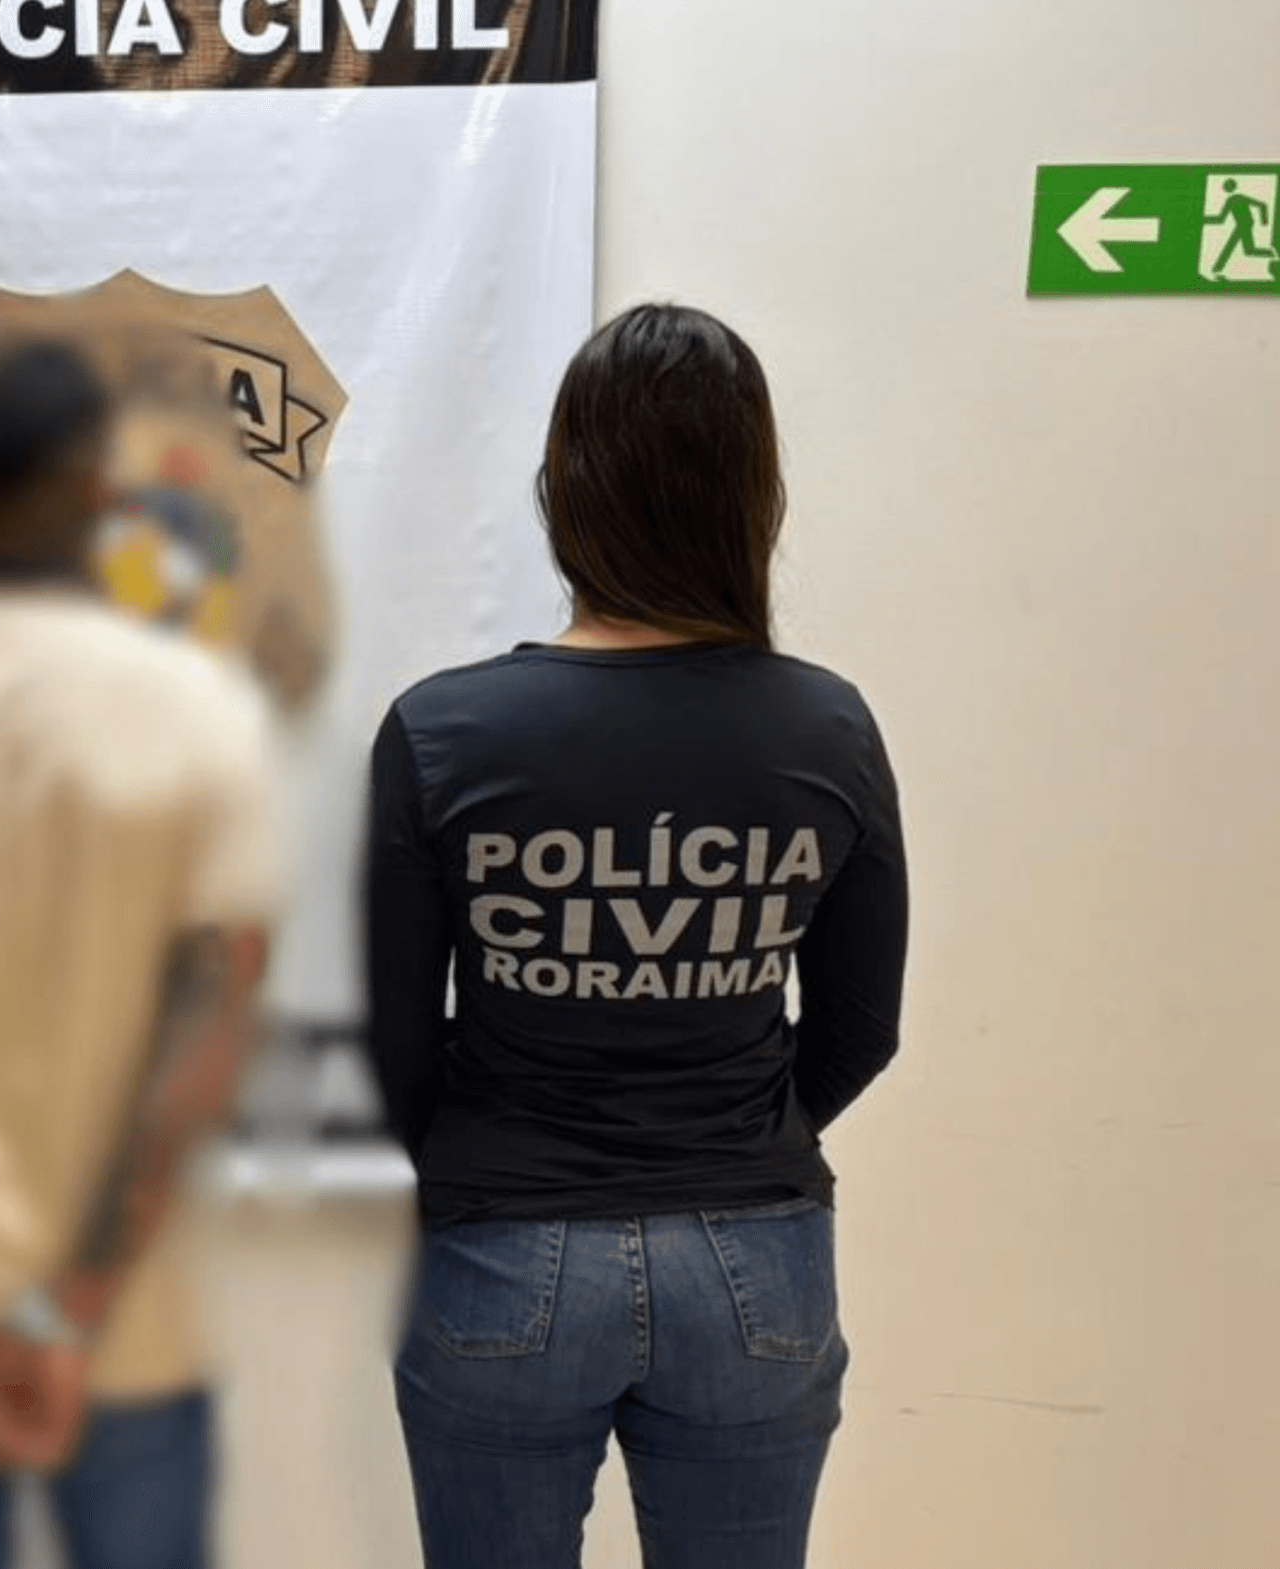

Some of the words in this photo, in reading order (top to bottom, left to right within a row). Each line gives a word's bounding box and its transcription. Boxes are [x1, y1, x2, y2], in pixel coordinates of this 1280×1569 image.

[220, 0, 510, 54] CIVIL
[466, 811, 822, 888] POLÍCIA
[469, 893, 806, 955] CIVIL
[483, 946, 786, 999] RORAIMA
